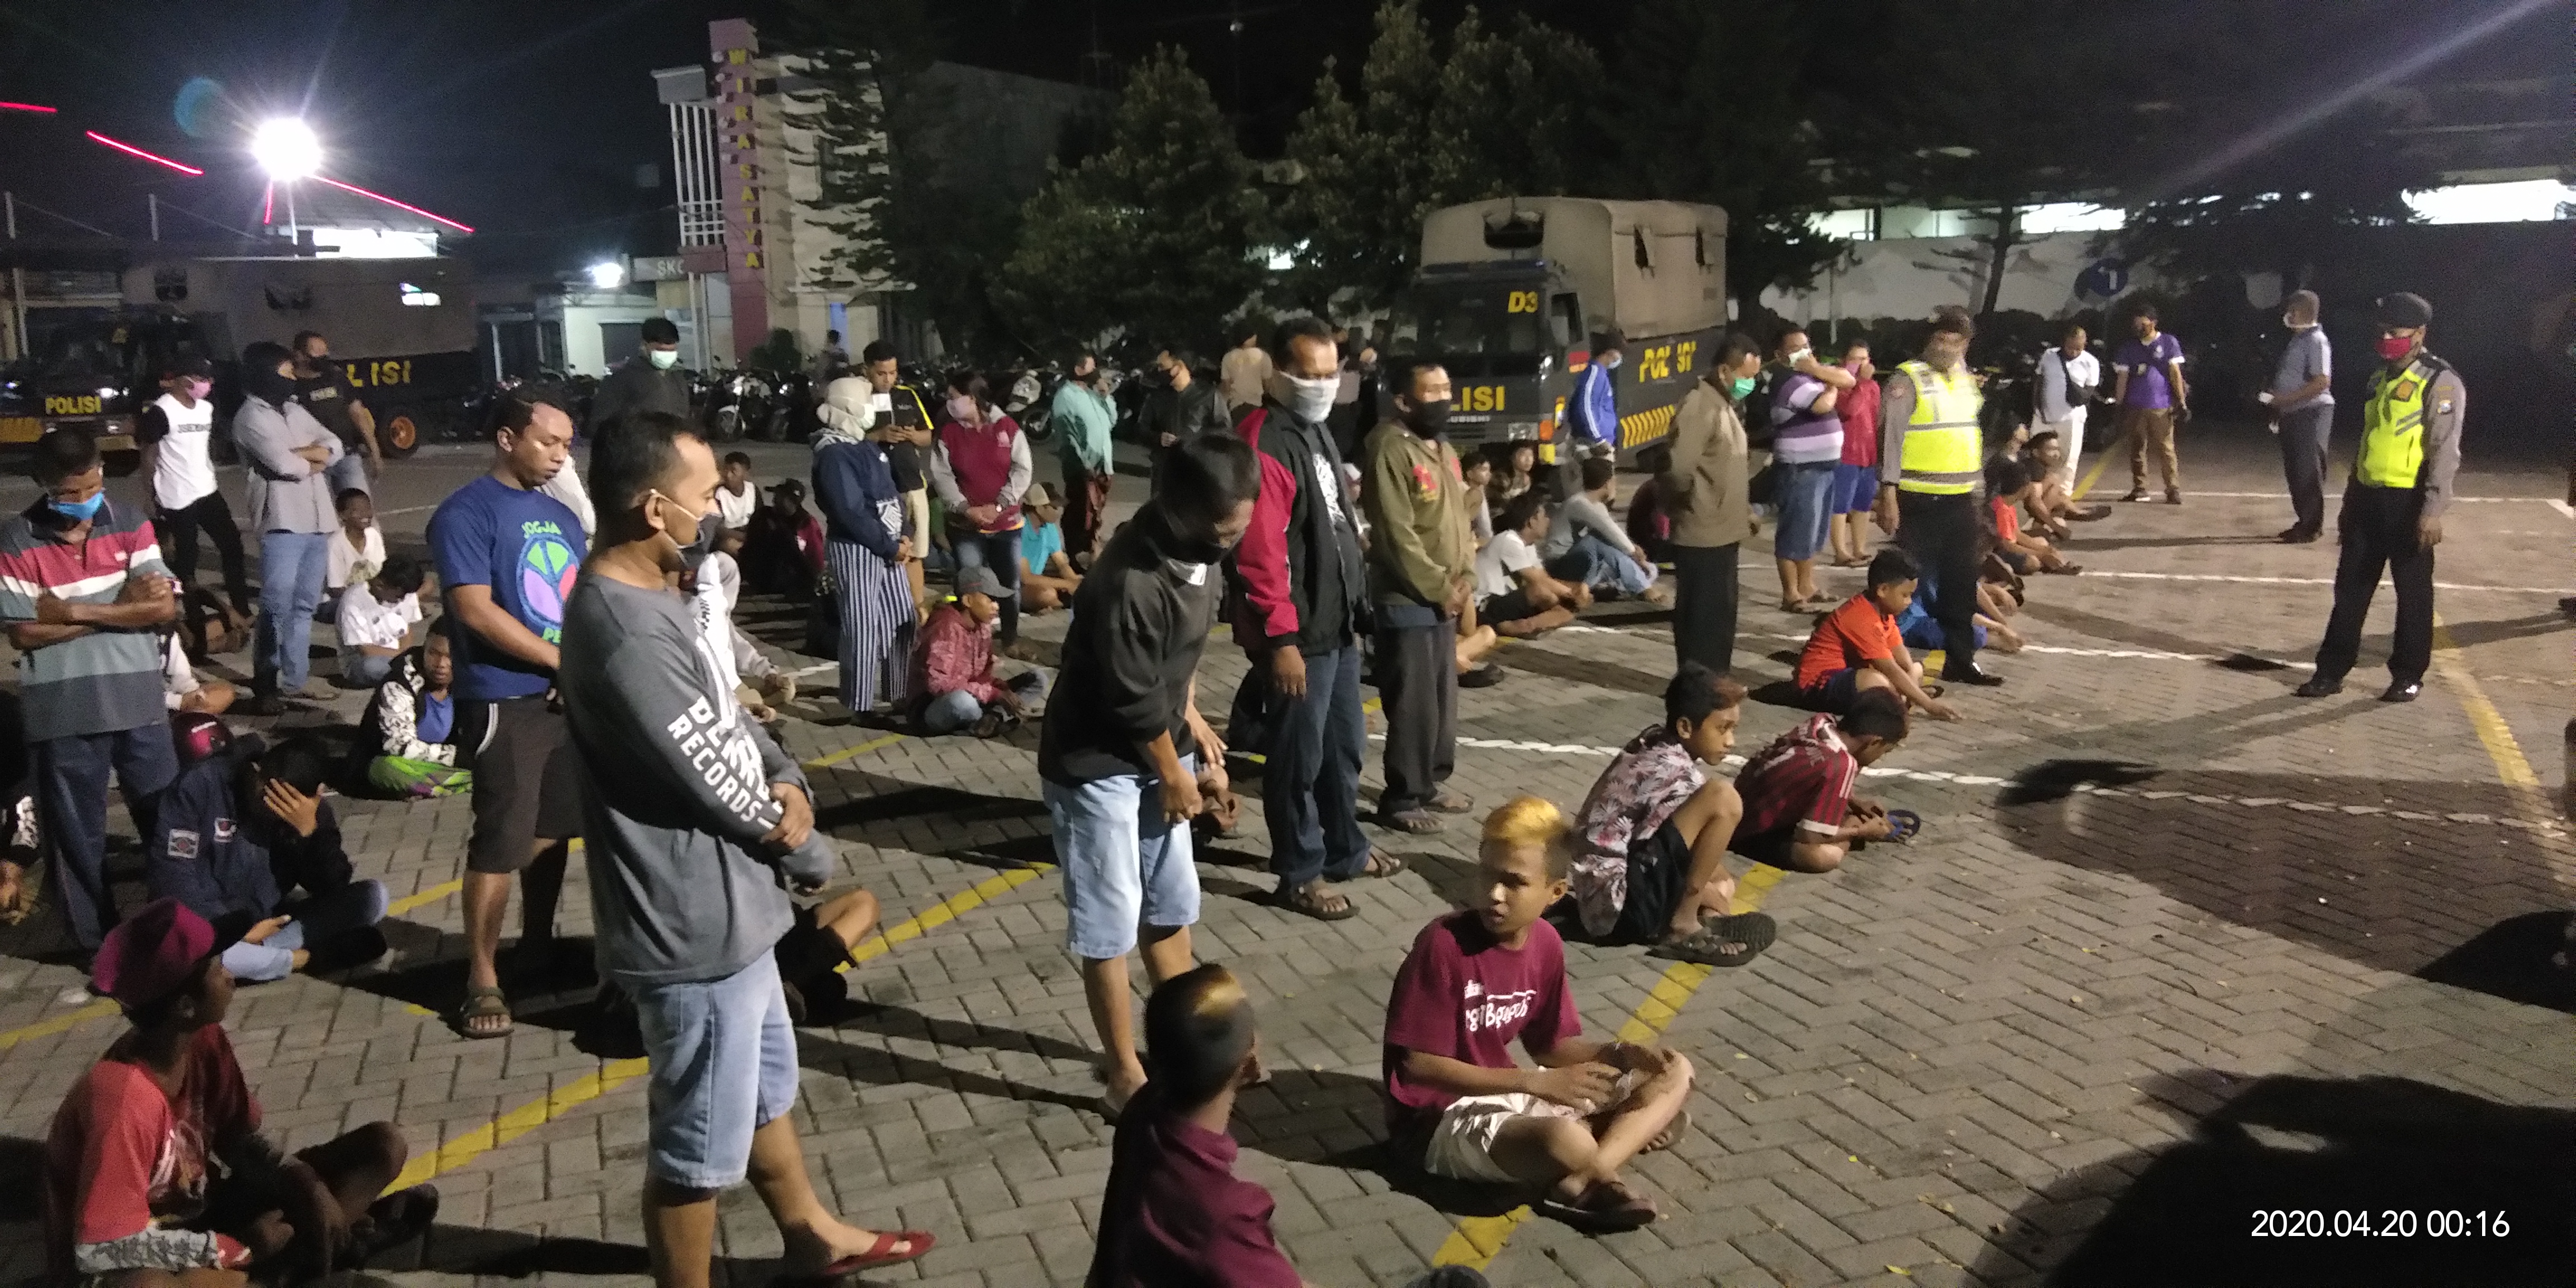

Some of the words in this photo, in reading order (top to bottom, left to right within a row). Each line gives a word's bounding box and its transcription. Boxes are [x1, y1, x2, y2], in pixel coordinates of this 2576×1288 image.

[1508, 291, 1538, 313] D3
[45, 395, 102, 414] POLISI
[667, 713, 763, 823] RECORDS
